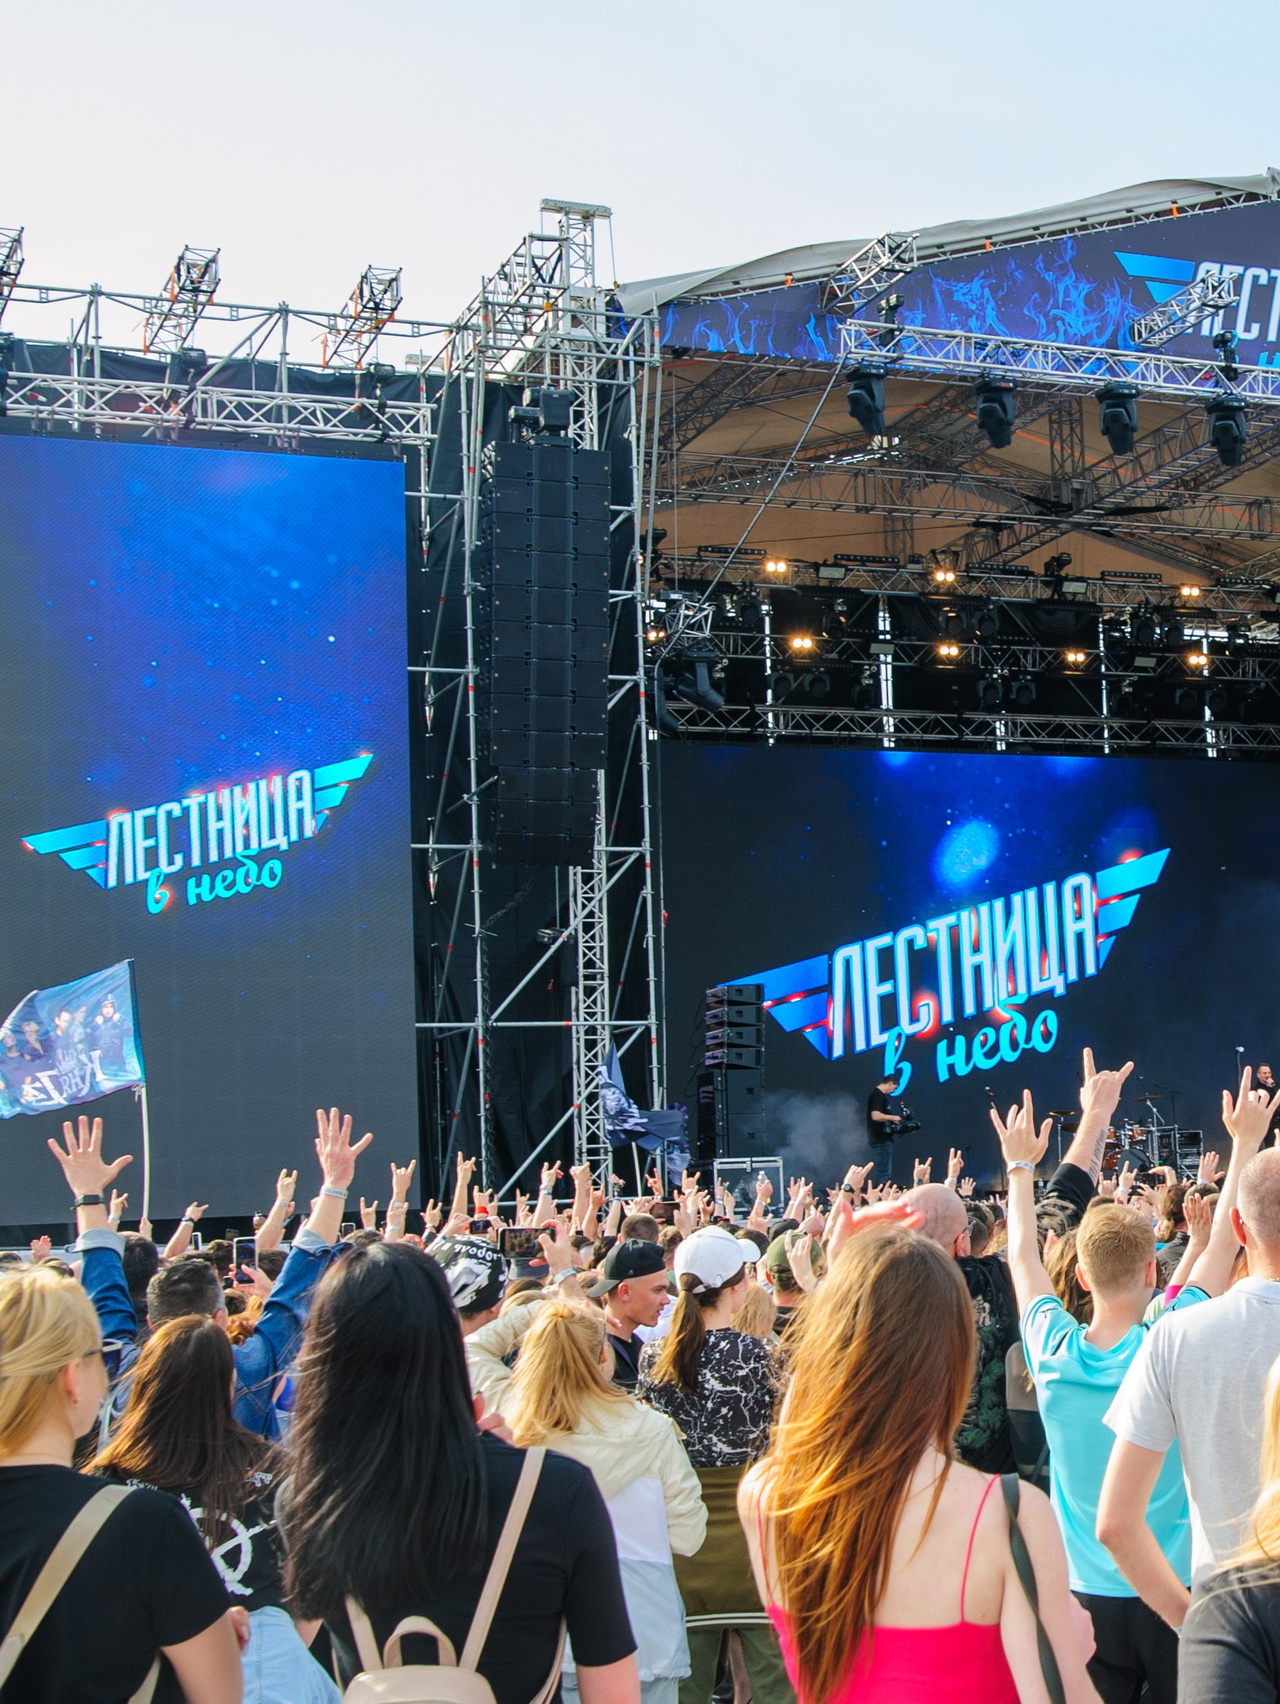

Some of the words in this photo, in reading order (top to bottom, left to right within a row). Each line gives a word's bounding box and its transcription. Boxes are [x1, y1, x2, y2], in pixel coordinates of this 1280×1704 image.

[106, 769, 315, 890] ЛЕСТНИЦА
[187, 849, 283, 906] небо
[831, 872, 1097, 1062] ЛЕСТНИЦА
[936, 993, 1058, 1083] небо
